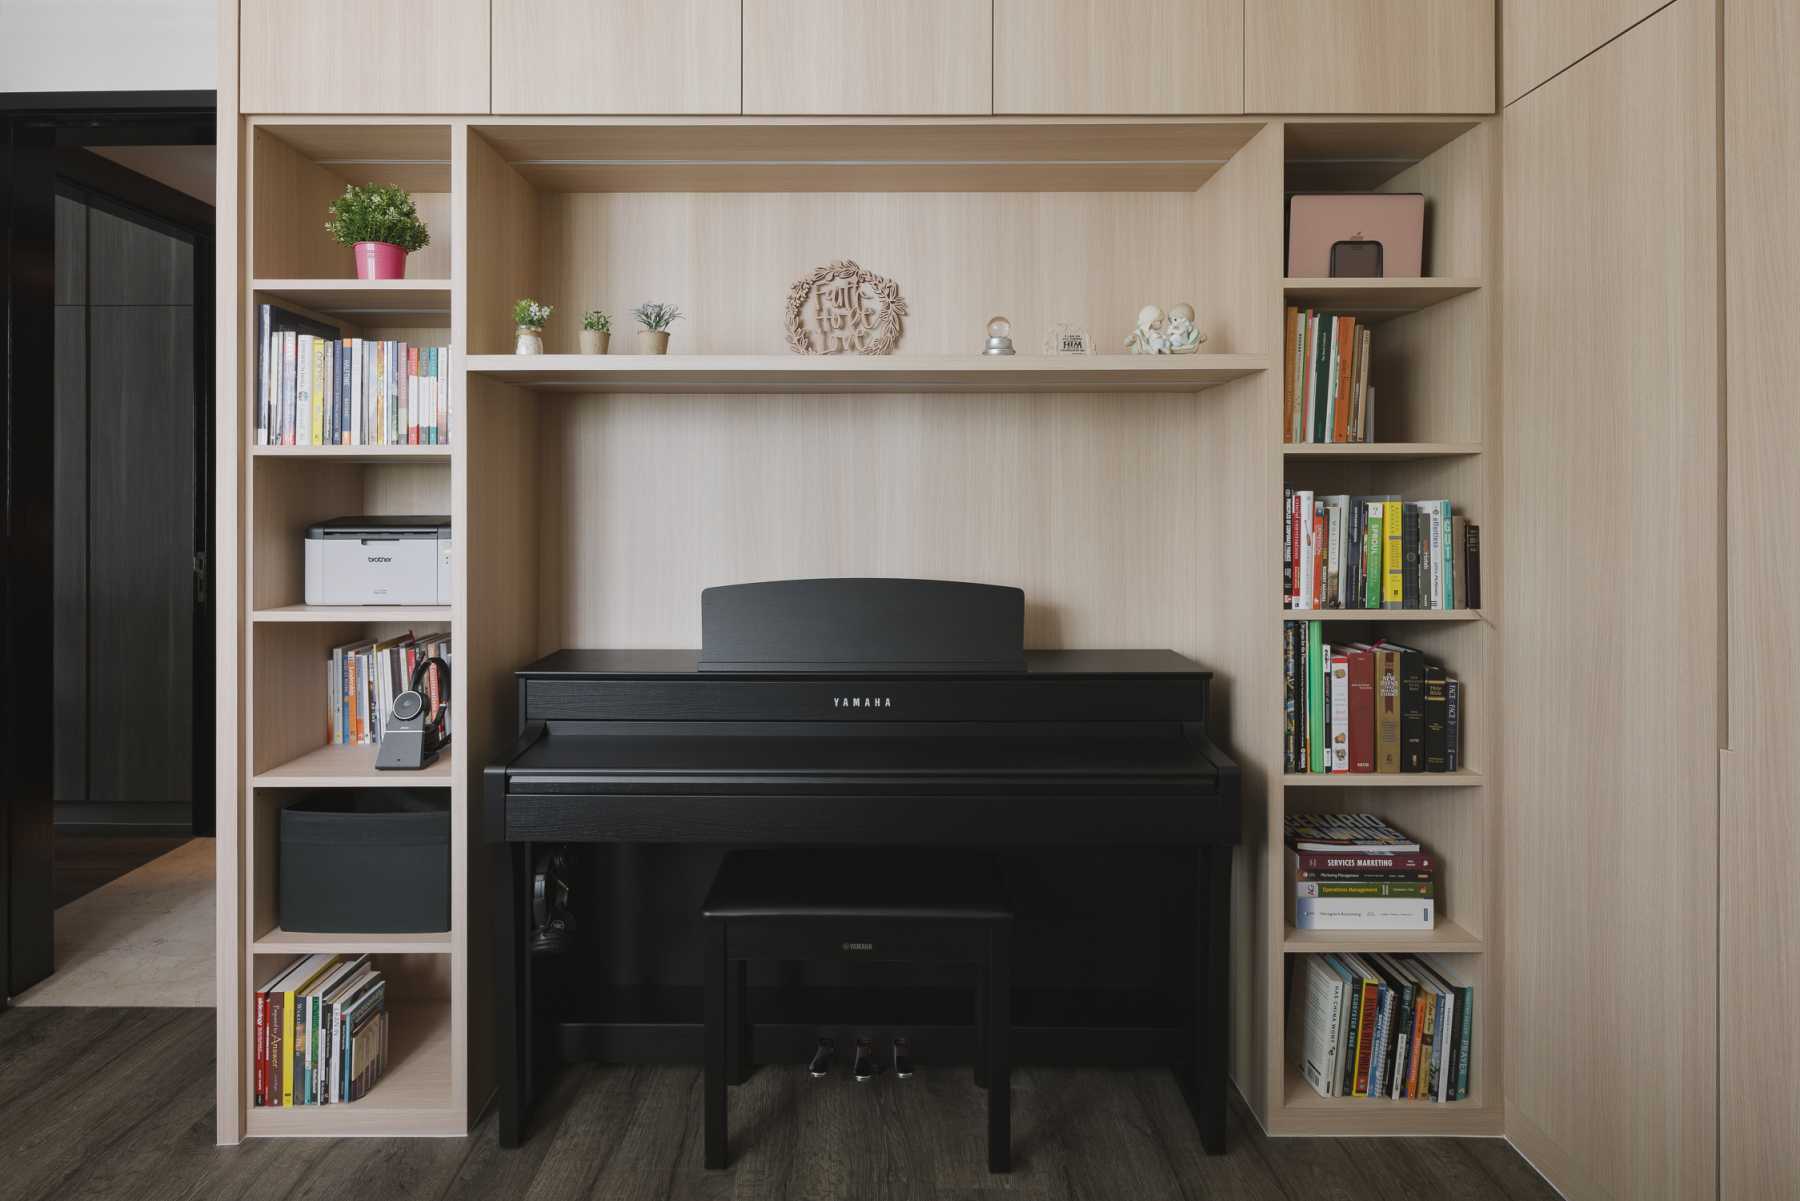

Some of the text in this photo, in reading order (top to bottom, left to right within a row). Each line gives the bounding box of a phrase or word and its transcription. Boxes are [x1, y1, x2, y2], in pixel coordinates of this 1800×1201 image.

[833, 697, 891, 707] YAMAHA
[1327, 859, 1393, 867] SERVICES MARKETING
[271, 1034, 282, 1068] Answer
[1459, 1039, 1469, 1075] PRAYER
